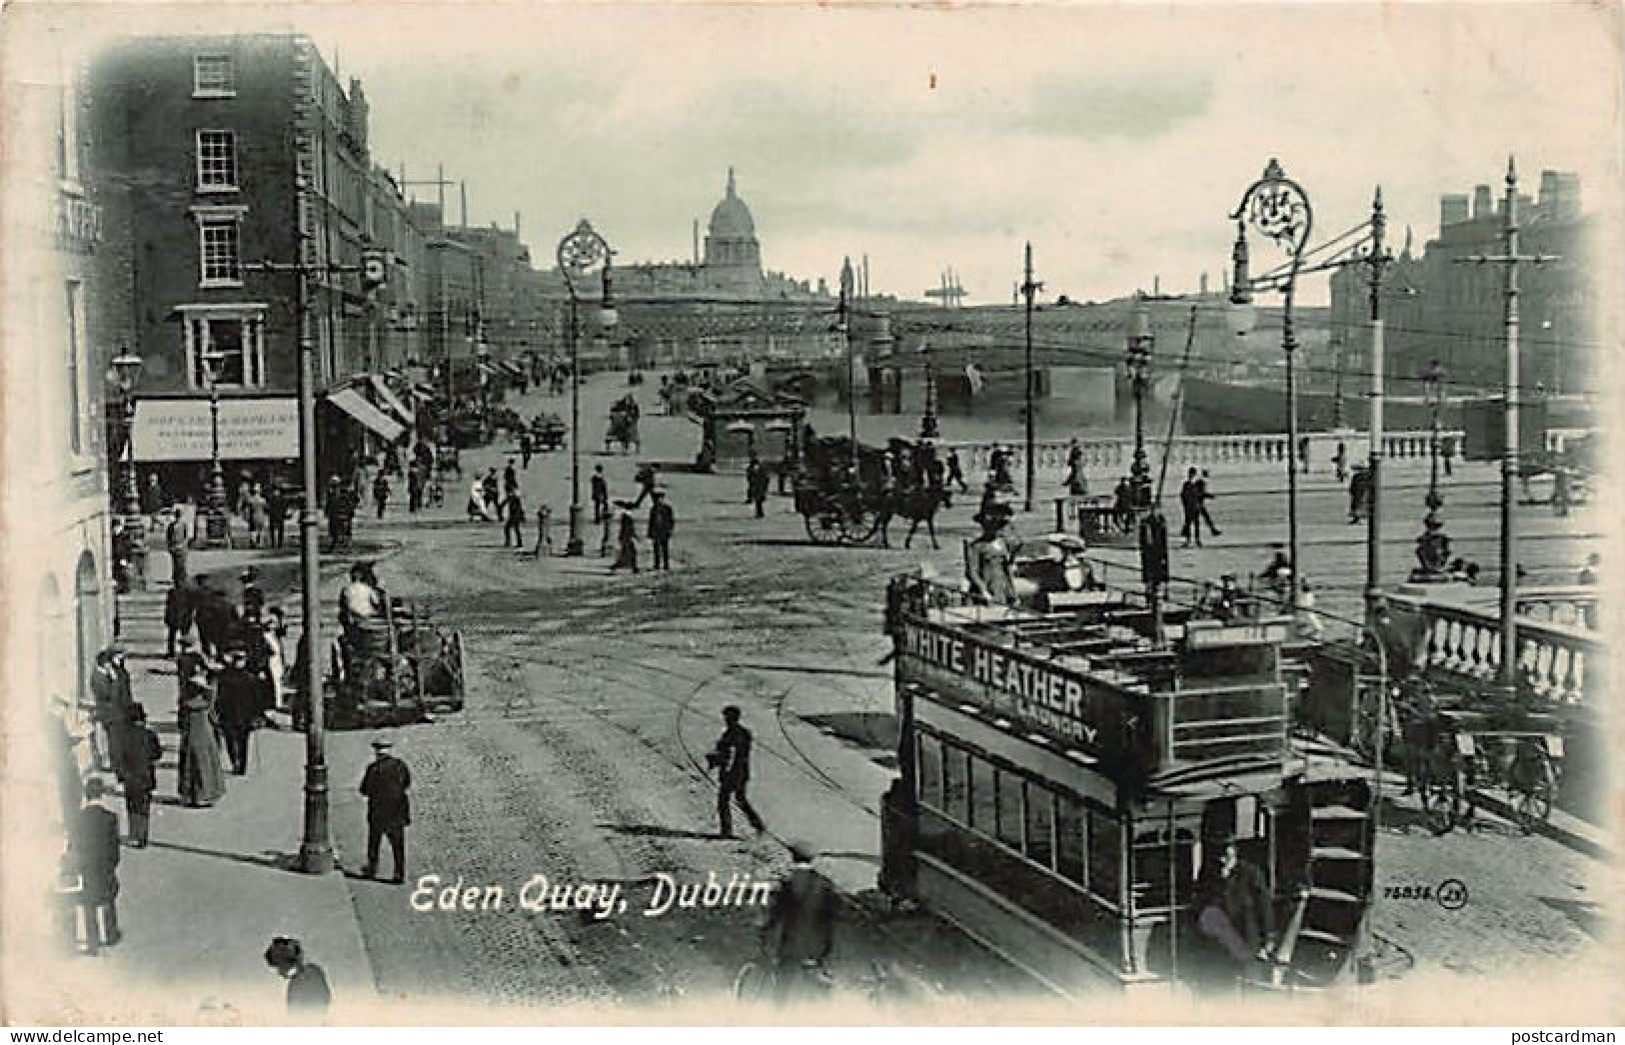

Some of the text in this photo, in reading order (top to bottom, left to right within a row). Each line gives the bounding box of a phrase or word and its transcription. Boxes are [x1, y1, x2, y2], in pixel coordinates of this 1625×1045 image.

[904, 624, 965, 671] WHITE
[974, 646, 1083, 717] HEATHER
[1017, 698, 1098, 743] LAUNDRY
